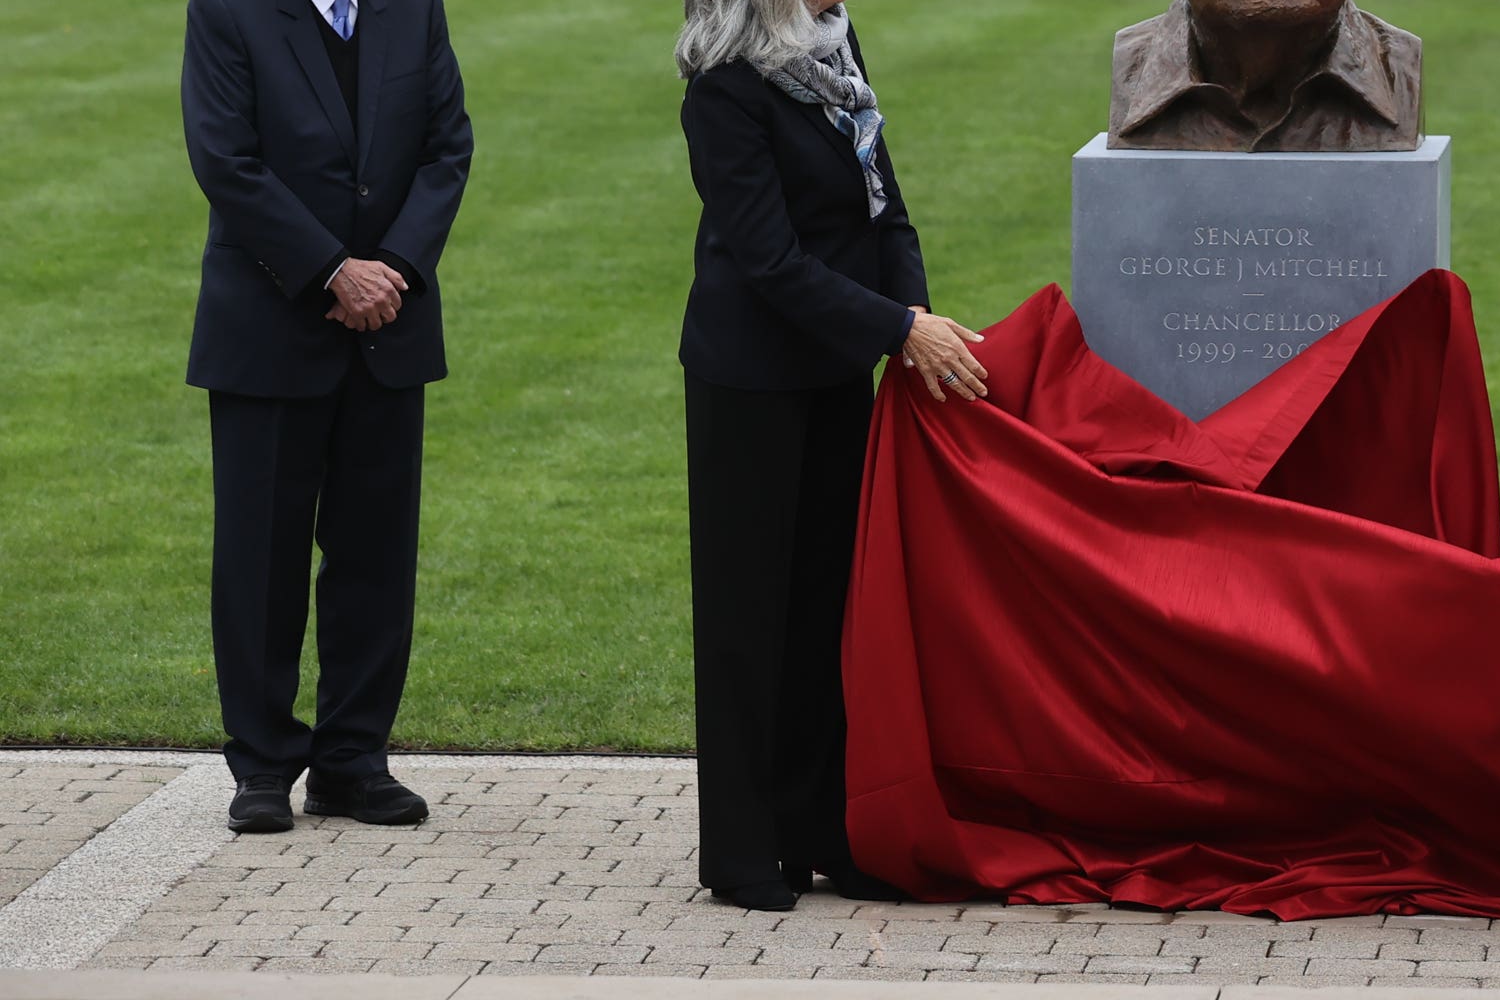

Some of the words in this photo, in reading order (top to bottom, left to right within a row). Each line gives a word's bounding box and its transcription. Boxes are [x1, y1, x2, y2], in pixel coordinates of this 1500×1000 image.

[1193, 226, 1314, 247] SENATOR
[1119, 256, 1226, 277] GEORGE
[1236, 257, 1243, 282] J
[1255, 258, 1388, 277] MITCHELL
[1163, 312, 1341, 332] CHANCELLOR
[1177, 342, 1236, 363] 1999
